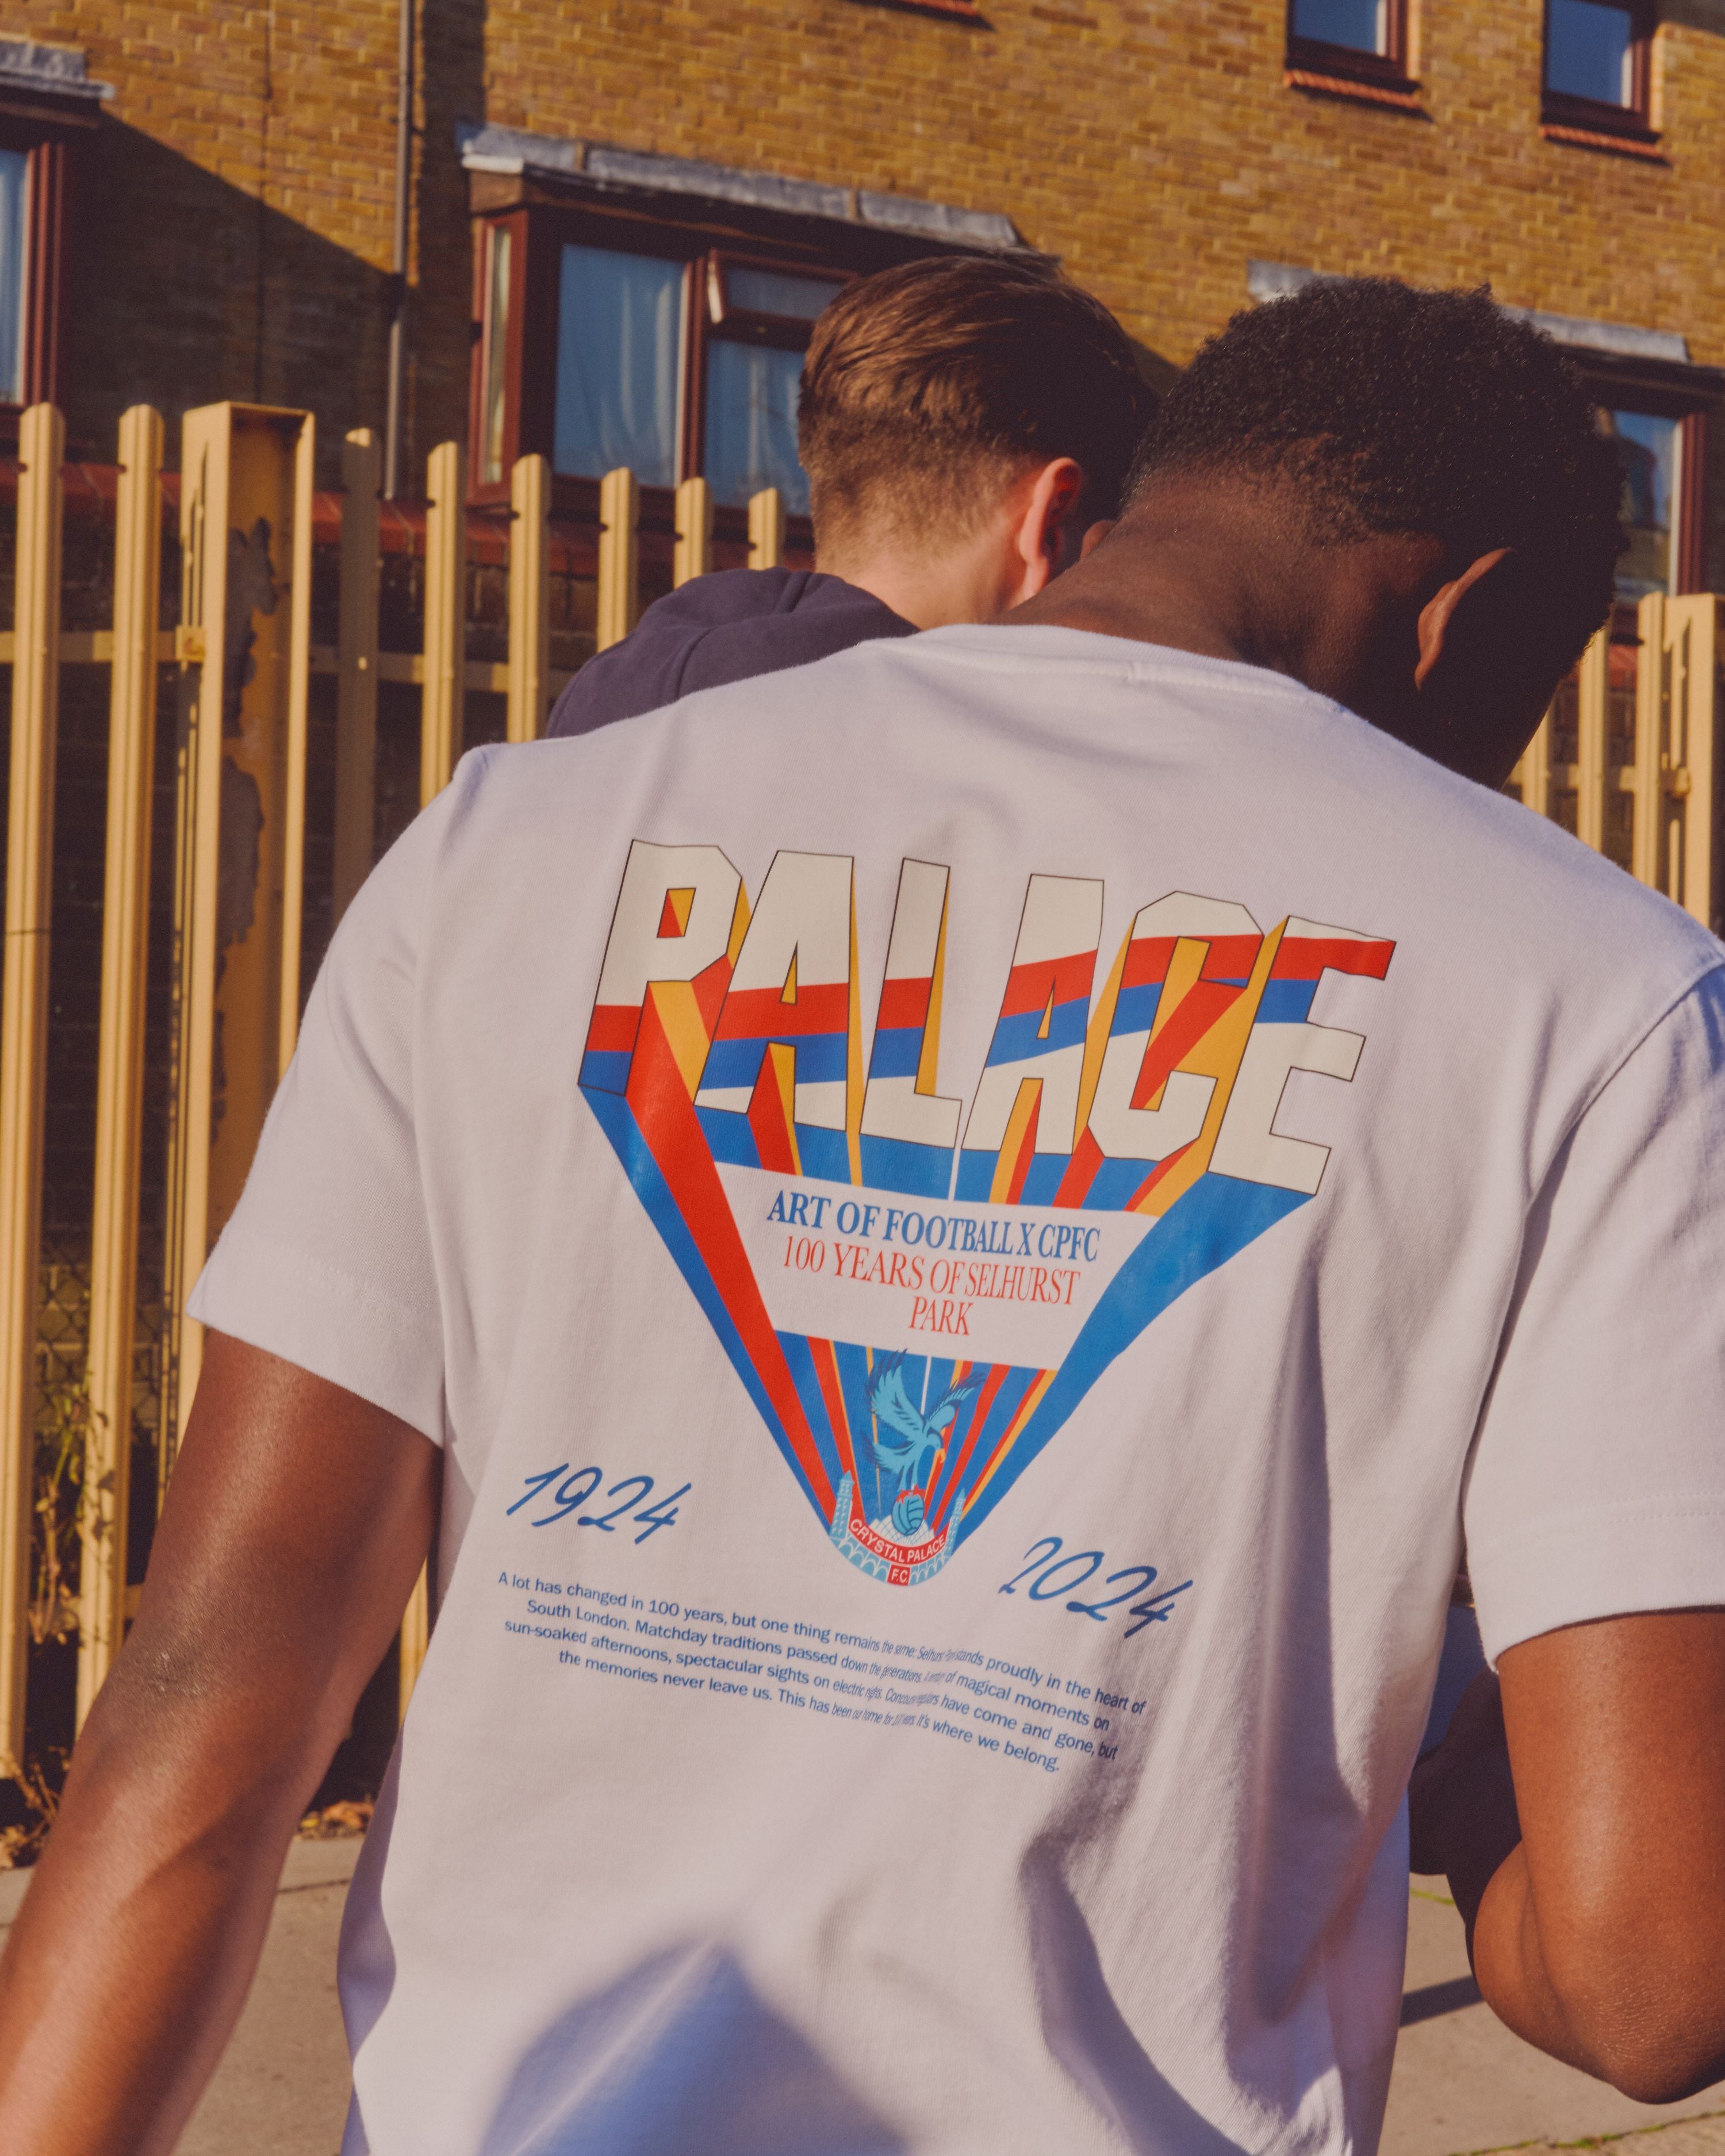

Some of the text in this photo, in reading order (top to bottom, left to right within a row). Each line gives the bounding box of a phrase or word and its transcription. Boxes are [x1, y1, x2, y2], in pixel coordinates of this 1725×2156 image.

[578, 839, 1396, 1195] PALACE
[767, 1190, 1101, 1263] ART OF FOOTBALL X CPFC
[784, 1236, 1080, 1306] 100 YEARS OF SELHURST
[907, 1296, 973, 1336] PARK
[505, 1462, 692, 1545] 1924
[850, 1518, 945, 1563] CRYSTAL PALACE
[998, 1536, 1194, 1639] 2024
[498, 1572, 508, 1585] A
[512, 1575, 530, 1590] lot
[535, 1578, 562, 1594] has
[567, 1583, 627, 1606] changed
[631, 1595, 644, 1610] in
[649, 1599, 679, 1616] 100
[684, 1608, 727, 1626] years,
[731, 1612, 757, 1628] but
[761, 1619, 788, 1633] one
[794, 1622, 831, 1644] thing
[835, 1631, 880, 1652] remains
[881, 1640, 894, 1655] the
[986, 1657, 1043, 1687] proudly
[1046, 1673, 1061, 1690] in
[1065, 1680, 1091, 1699] the
[1095, 1688, 1129, 1710] heart
[1132, 1701, 1147, 1714] of
[505, 1620, 587, 1644] sun-soaked
[591, 1636, 672, 1665] afternoons,
[676, 1652, 764, 1675] spectacular
[766, 1664, 810, 1685] sights
[814, 1675, 830, 1689] on
[833, 1679, 865, 1698] electric
[940, 1694, 970, 1714] have
[973, 1707, 1018, 1730] come
[1022, 1722, 1053, 1740] and
[1055, 1732, 1095, 1758] gone,
[1098, 1741, 1118, 1761] but
[527, 1599, 571, 1618] South
[576, 1606, 630, 1631] London.
[635, 1620, 708, 1646] Matchday
[712, 1633, 782, 1654] traditions
[787, 1645, 837, 1666] passed
[841, 1656, 868, 1674] down
[869, 1662, 881, 1675] the
[945, 1671, 957, 1683] of
[956, 1674, 1011, 1700] magical
[1014, 1692, 1090, 1726] moments
[1093, 1717, 1110, 1731] on
[558, 1649, 581, 1666] the
[585, 1656, 658, 1683] memories
[663, 1673, 705, 1689] never
[709, 1678, 749, 1696] leave
[753, 1687, 773, 1701] us.
[778, 1688, 806, 1708] This
[809, 1695, 830, 1714] has
[831, 1702, 853, 1719] been
[932, 1720, 973, 1743] where
[977, 1735, 999, 1751] we
[1004, 1740, 1059, 1773] belong.
